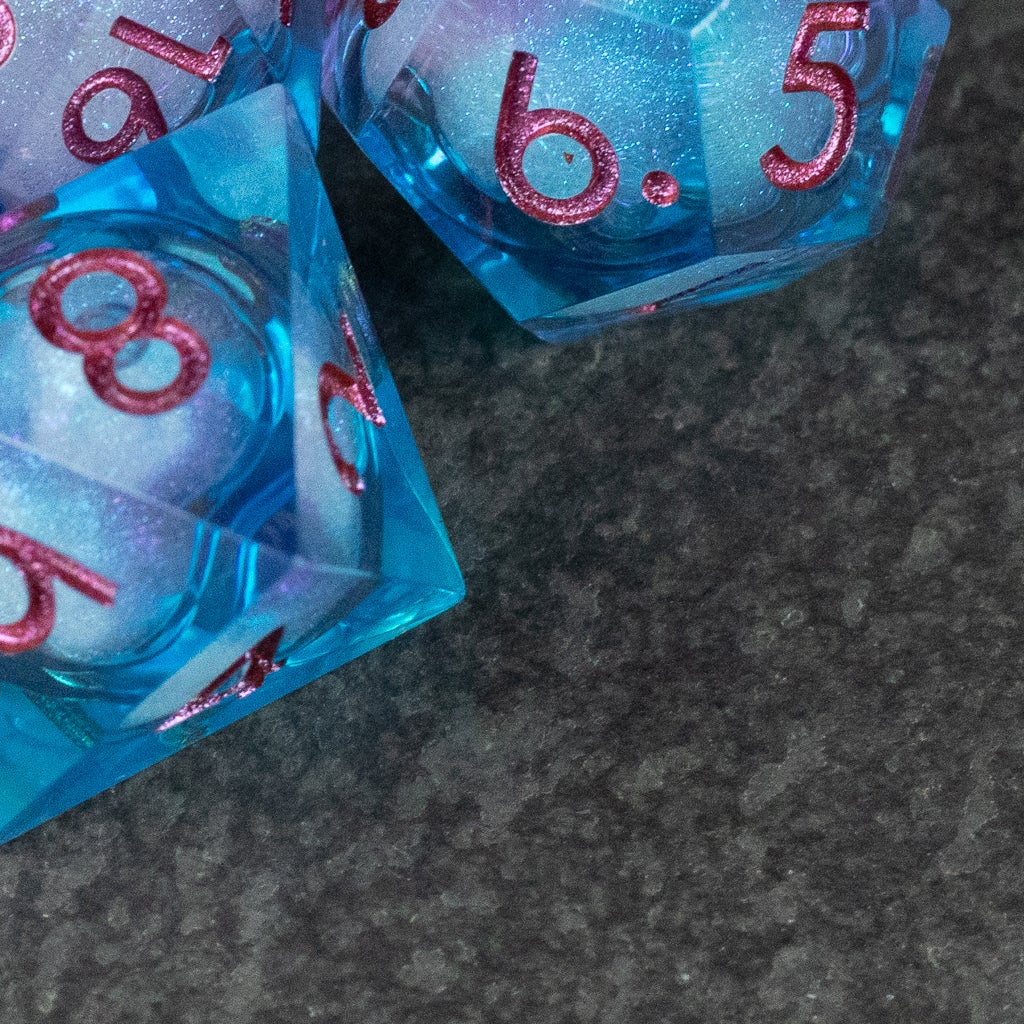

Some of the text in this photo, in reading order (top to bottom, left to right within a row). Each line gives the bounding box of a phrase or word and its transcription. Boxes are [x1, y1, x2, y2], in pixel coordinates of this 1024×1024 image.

[493, 50, 681, 226] 6.
[759, 0, 872, 191] 5
[29, 248, 212, 416] 8
